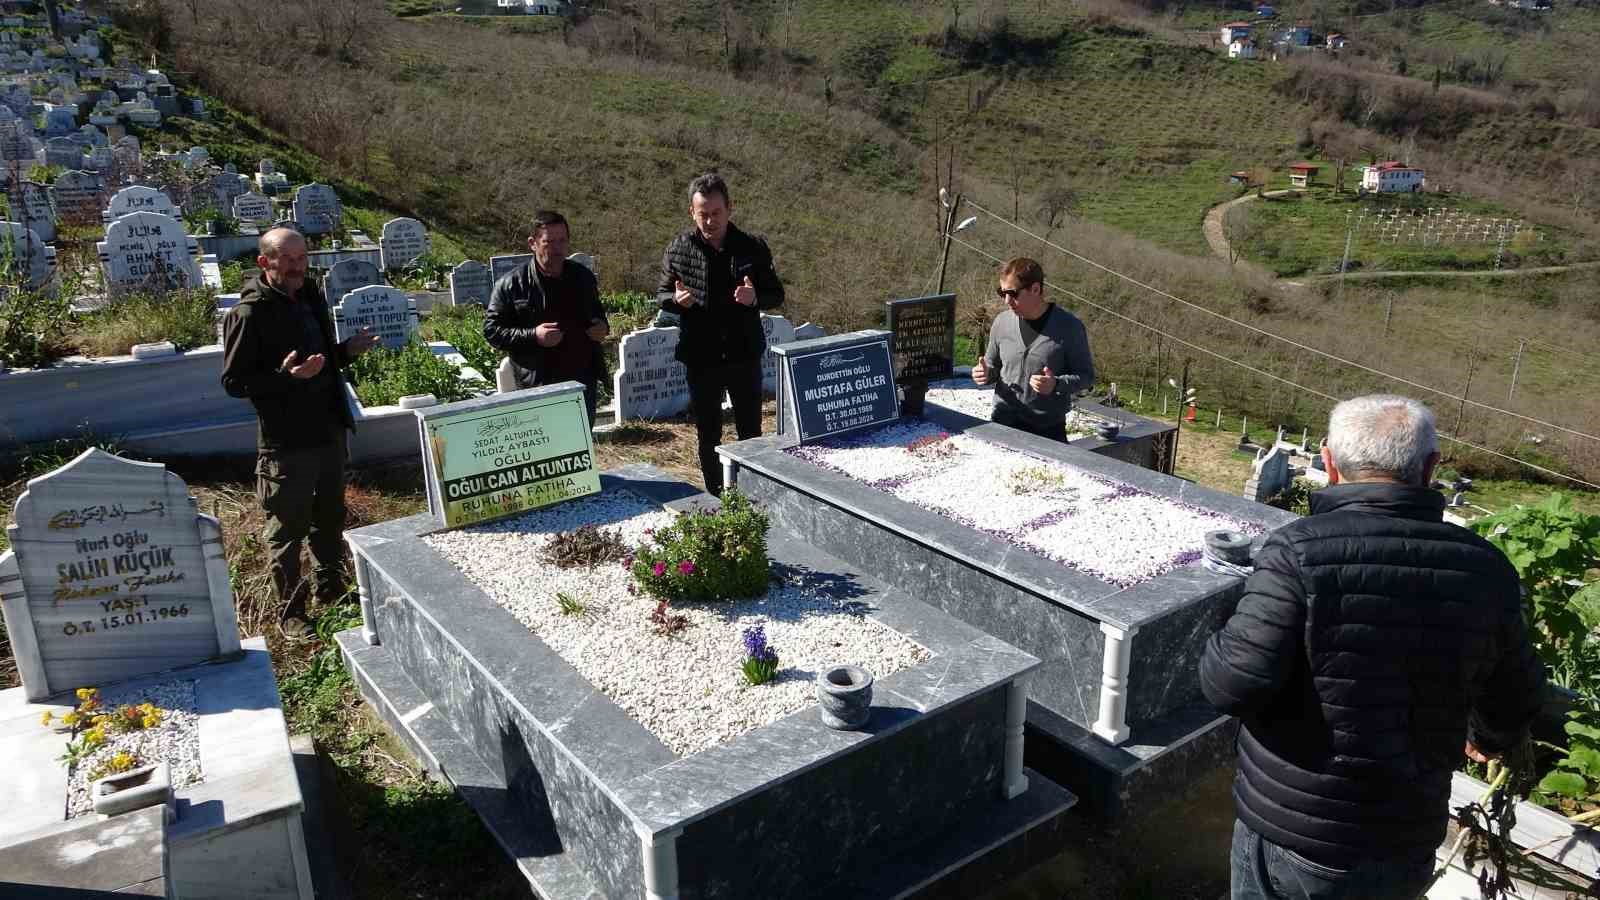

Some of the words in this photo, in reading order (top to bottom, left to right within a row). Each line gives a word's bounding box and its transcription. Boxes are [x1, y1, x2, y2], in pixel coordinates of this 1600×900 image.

[804, 382, 853, 401] MUSTAFA
[855, 374, 886, 390] GÜLER
[817, 398, 852, 413] RUHUNA
[852, 391, 879, 406] FATİHA
[474, 437, 499, 449] SEDAT
[504, 427, 544, 442] ALTUNTAŞ
[472, 446, 505, 459] YILDIZ
[494, 451, 532, 468] OĞLU
[449, 469, 518, 498] OĞULCAN
[522, 453, 592, 482] ALTUNTAŞ
[463, 490, 523, 512] RUHUNA
[527, 477, 576, 495] FATİHA
[113, 530, 148, 550] Oğlu
[56, 555, 109, 584] SALİH
[114, 545, 175, 575] KÜÇÜK
[101, 603, 189, 630] 15.01.1966
